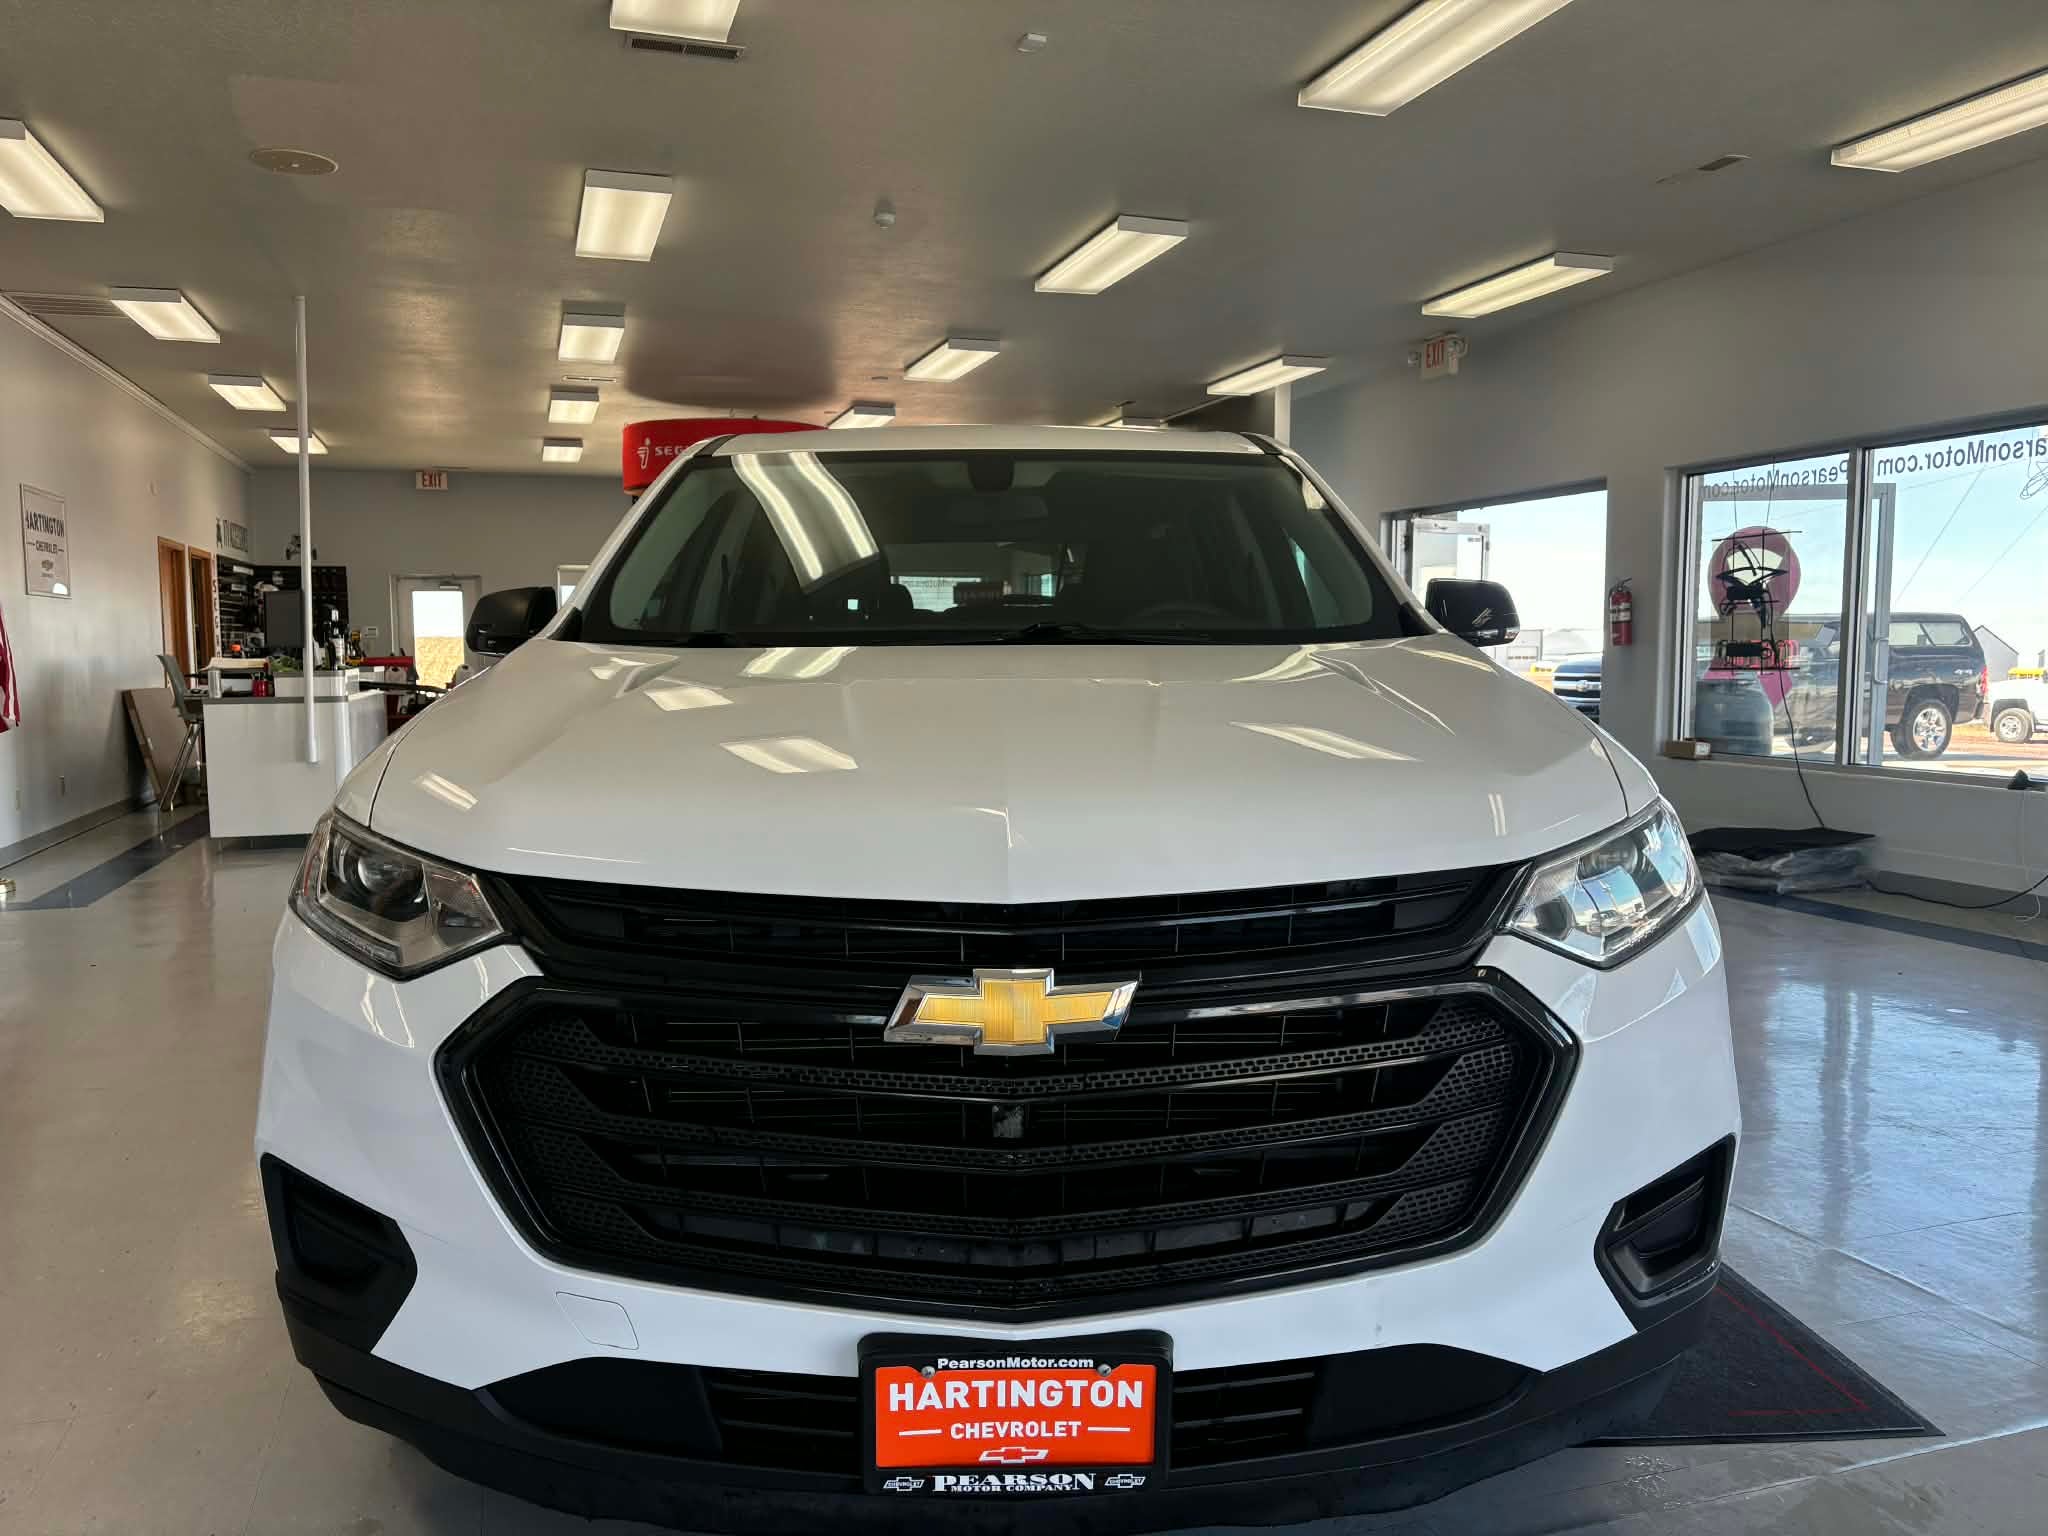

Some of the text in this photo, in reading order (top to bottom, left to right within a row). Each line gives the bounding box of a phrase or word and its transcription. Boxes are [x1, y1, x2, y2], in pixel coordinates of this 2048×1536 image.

[1426, 339, 1446, 368] EXIT
[655, 446, 688, 456] SEG
[422, 471, 442, 488] EXIT
[937, 1357, 1094, 1369] PearsonMotor.com
[889, 1379, 1143, 1412] HARTINGTON
[950, 1420, 1082, 1440] CHEVROLET
[932, 1472, 1097, 1492] PEARSON
[1006, 1484, 1073, 1492] COMPANY
